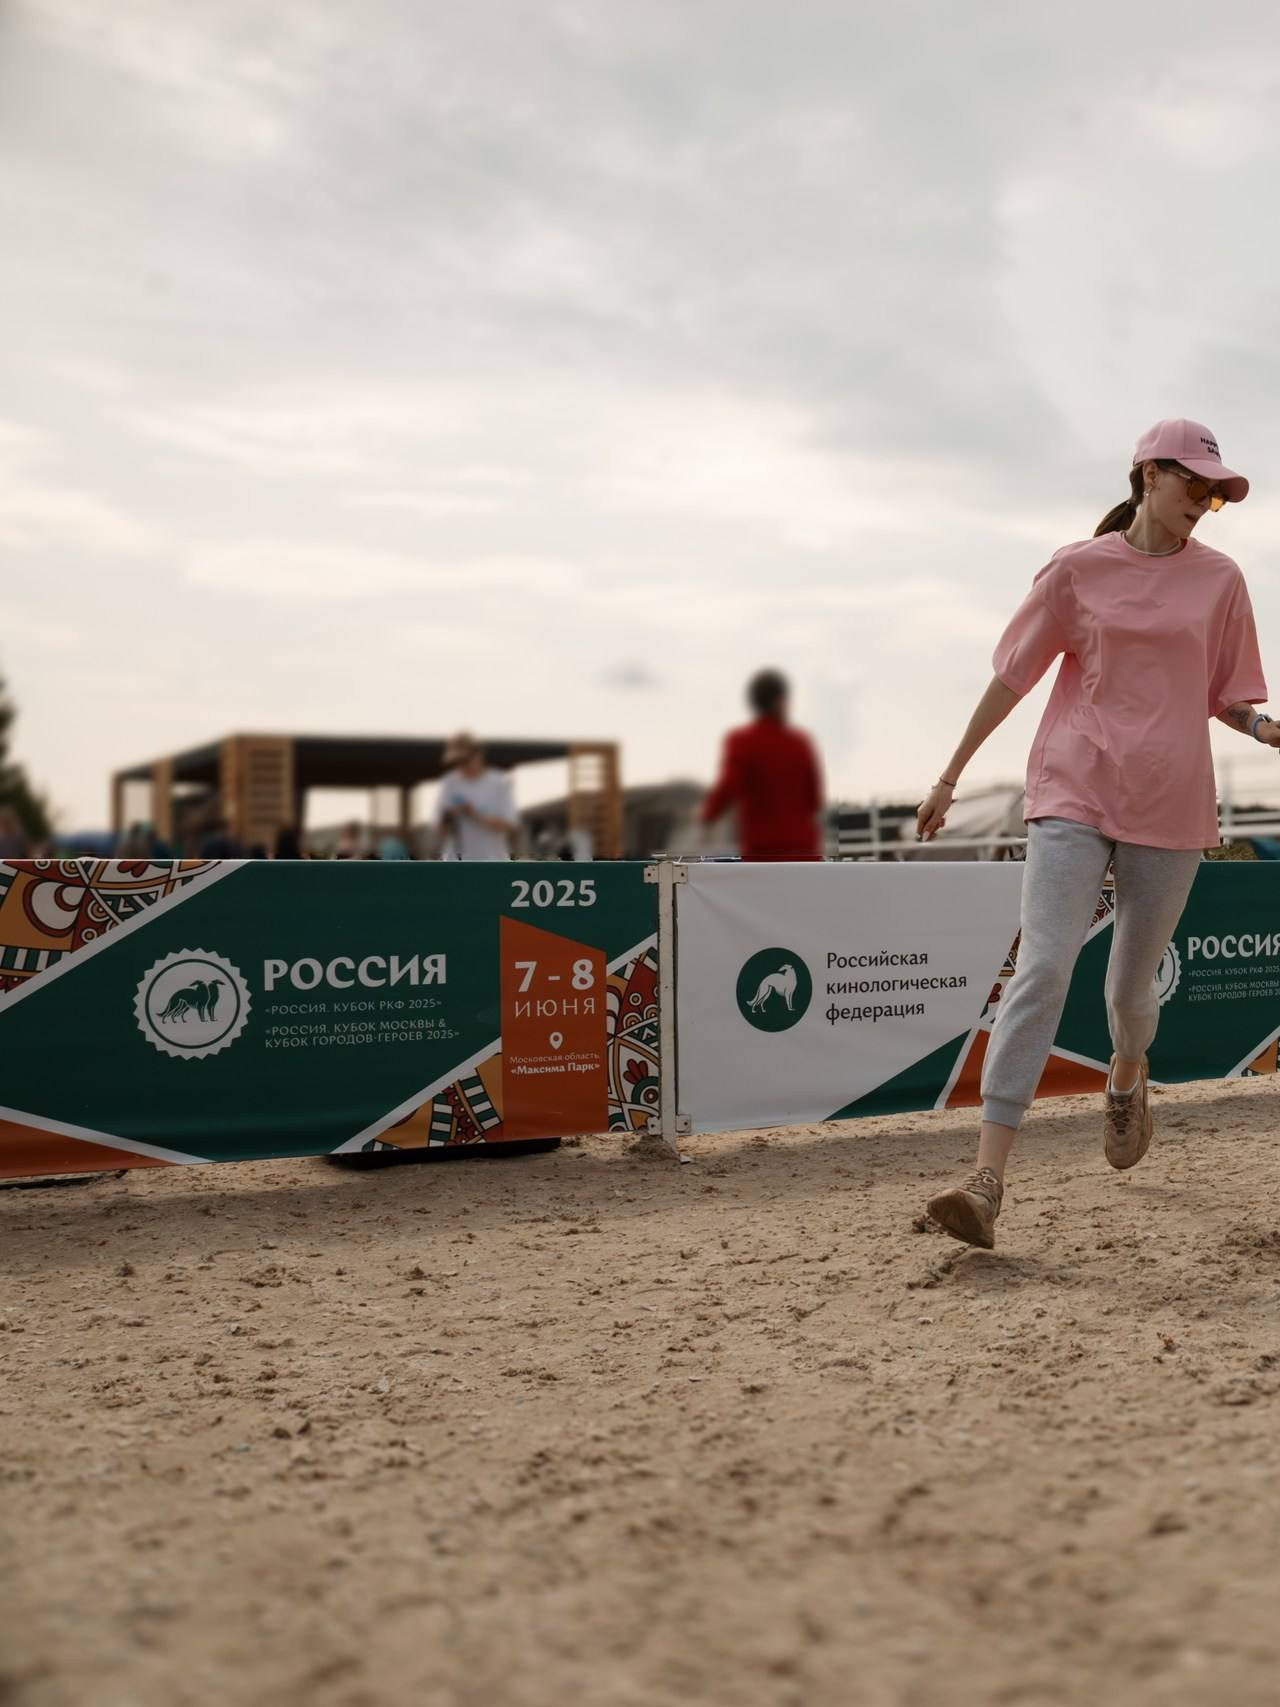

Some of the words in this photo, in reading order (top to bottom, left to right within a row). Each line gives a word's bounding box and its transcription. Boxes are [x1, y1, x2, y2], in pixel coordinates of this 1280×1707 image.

[511, 879, 597, 908] 2025
[827, 950, 928, 969] Российская
[264, 954, 447, 992] РОССИЯ
[514, 961, 538, 992] 7
[571, 959, 595, 990] 8
[1224, 967, 1248, 976] КУБОК
[826, 976, 967, 995] кинологическая
[1225, 982, 1249, 991] КУБОК
[334, 1000, 376, 1013] КУБОК
[379, 999, 405, 1011] РКФ
[408, 998, 442, 1009] 2025»
[514, 997, 596, 1018] ИЮНЯ
[826, 1003, 925, 1025] федерация
[334, 1021, 376, 1034] КУБОК
[379, 1018, 435, 1031] МОСКВЫ
[438, 1018, 447, 1028] &
[265, 1036, 309, 1049] КУБОК
[312, 1031, 423, 1045] ГОРОДОВ-ГЕРОЕВ
[427, 1029, 460, 1040] 2025»
[510, 1054, 563, 1064] Московская
[511, 1063, 565, 1075] «Максима
[567, 1062, 600, 1074] Парк»
